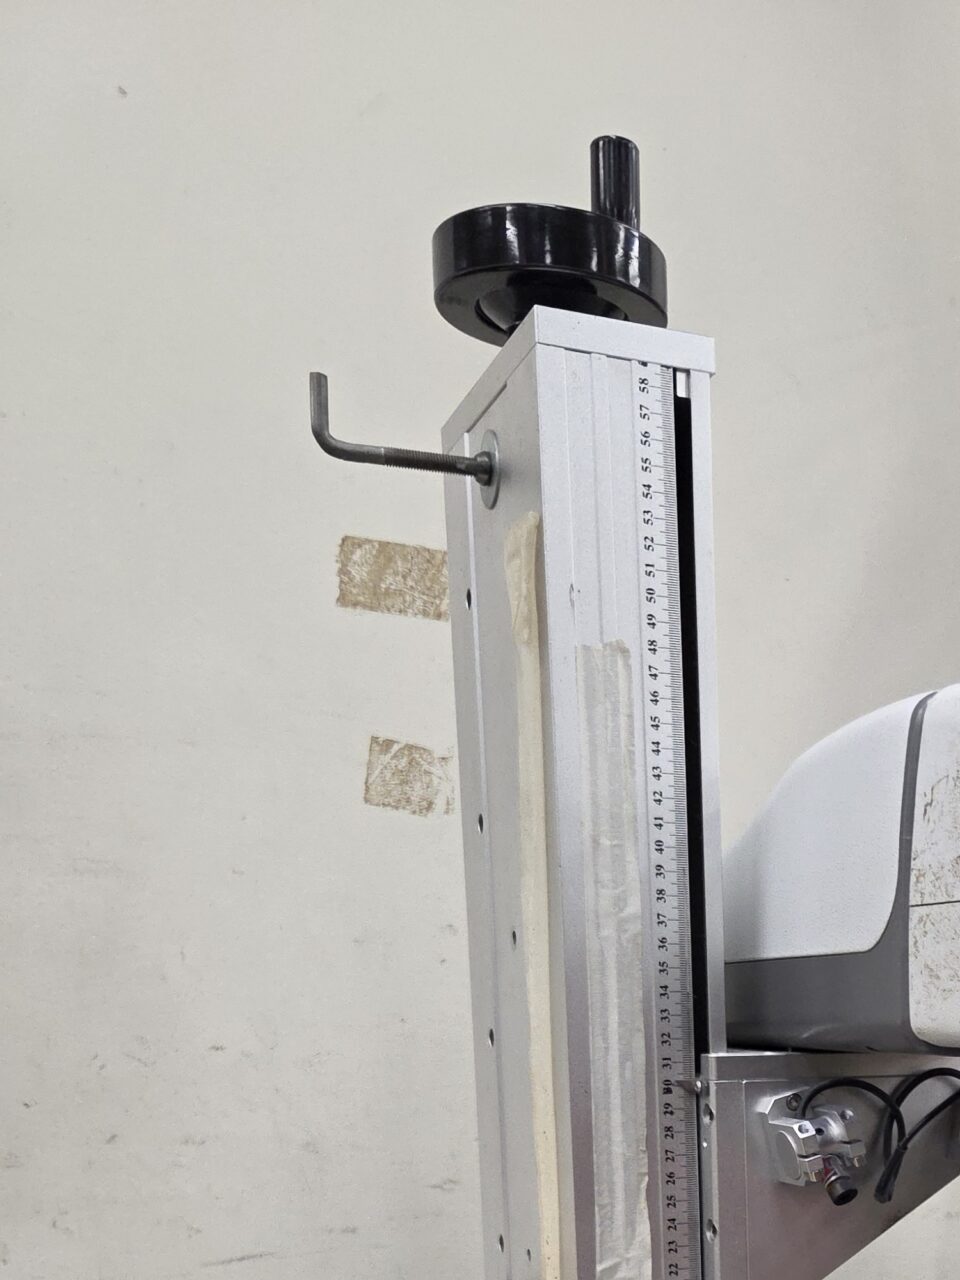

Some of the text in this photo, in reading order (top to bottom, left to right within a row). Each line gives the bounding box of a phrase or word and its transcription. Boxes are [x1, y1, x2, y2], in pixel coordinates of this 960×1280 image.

[639, 377, 649, 393] 58
[640, 404, 650, 420] 57
[641, 431, 651, 447] 56
[641, 457, 651, 473] 55
[643, 483, 652, 499] 54
[643, 509, 653, 525] 53
[644, 536, 654, 551] 52
[645, 563, 655, 577] 51
[646, 588, 656, 603] 50
[647, 614, 656, 629] 49
[648, 639, 657, 655] 48
[648, 665, 659, 680] 47
[649, 690, 659, 706] 46
[650, 715, 660, 731] 45
[651, 740, 660, 756] 44
[652, 766, 662, 781] 43
[653, 791, 663, 806] 42
[654, 815, 664, 830] 41
[655, 839, 664, 854] 40
[656, 864, 665, 879] 39
[656, 888, 666, 903] 38
[657, 913, 667, 927] 37
[658, 937, 667, 951] 36
[659, 961, 668, 975] 35
[660, 985, 669, 999] 34
[660, 1008, 671, 1023] 33
[661, 1032, 671, 1046] 32
[662, 1057, 672, 1069] 31
[665, 1126, 674, 1139] 28
[666, 1150, 675, 1162] 27
[667, 1172, 675, 1185] 26
[667, 1195, 676, 1208] 25
[668, 1218, 677, 1231] 24
[669, 1241, 677, 1254] 23
[669, 1263, 678, 1276] 22
